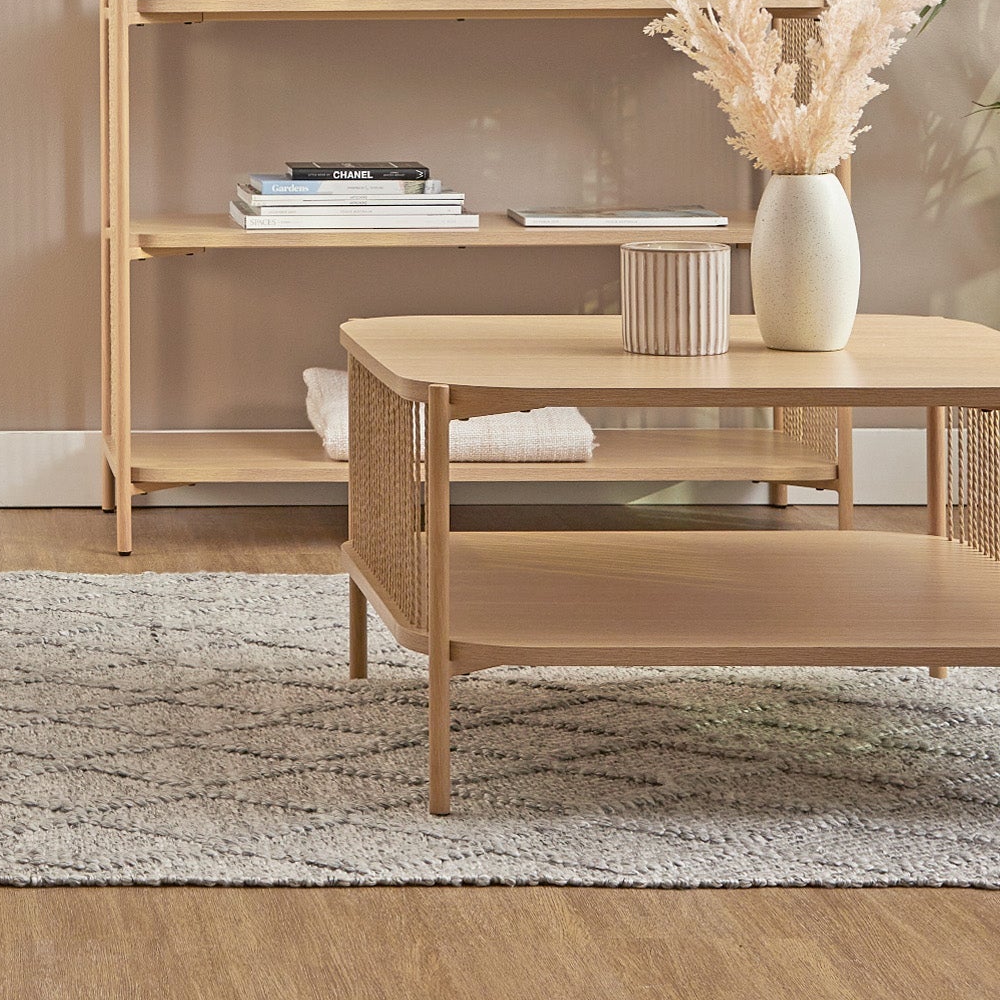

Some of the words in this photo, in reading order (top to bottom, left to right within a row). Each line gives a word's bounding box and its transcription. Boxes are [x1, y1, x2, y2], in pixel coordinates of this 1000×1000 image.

[333, 170, 374, 179] CHANEL
[271, 183, 310, 193] Gardens
[250, 218, 277, 226] SPACES
